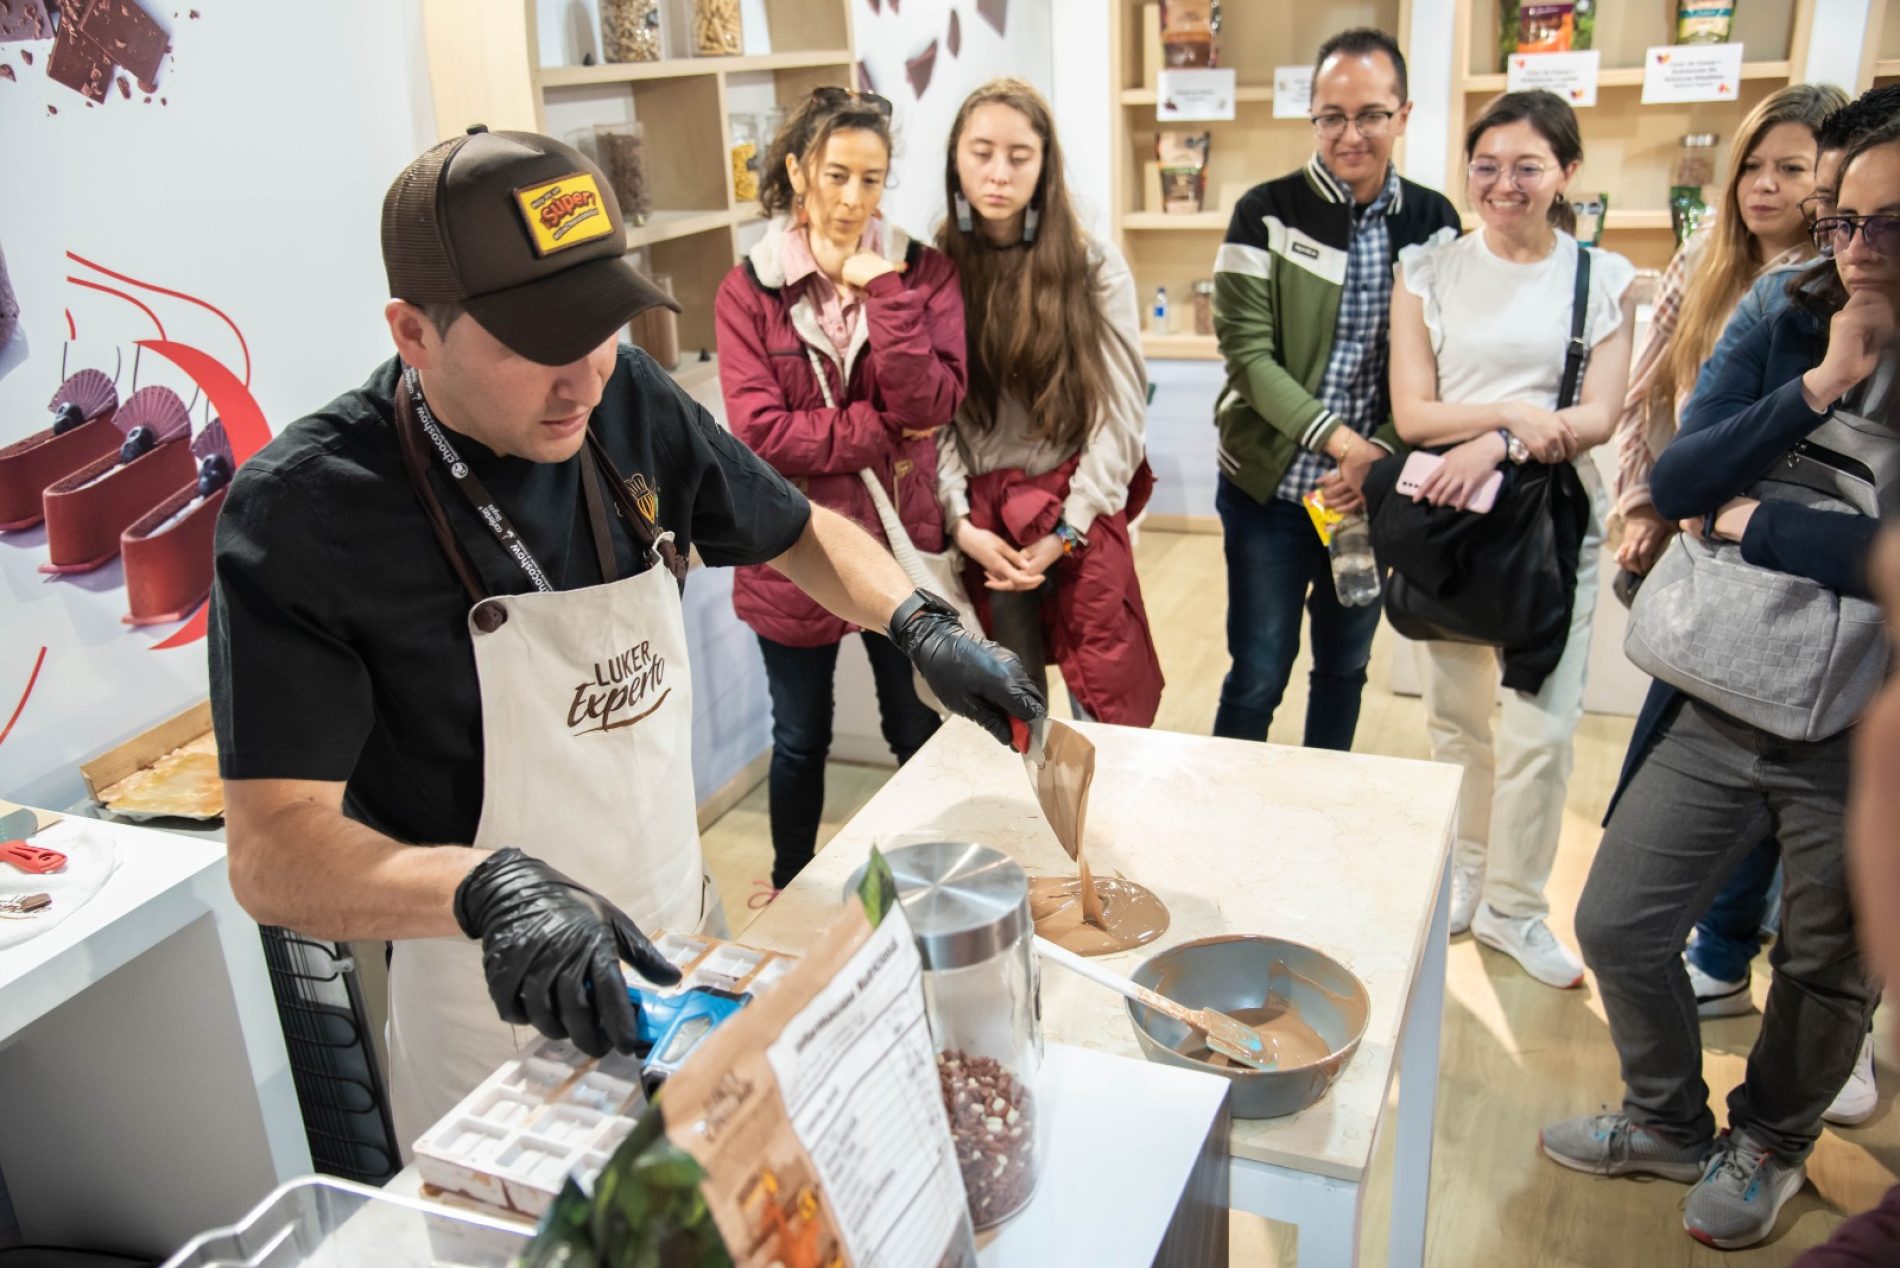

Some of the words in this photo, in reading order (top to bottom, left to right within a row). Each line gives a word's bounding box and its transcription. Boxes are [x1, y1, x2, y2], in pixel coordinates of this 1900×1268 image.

[540, 191, 596, 230] Super
[416, 406, 455, 463] chocoshow
[510, 544, 549, 592] hocoshow
[594, 640, 651, 687] LUKER
[567, 653, 665, 732] Experto
